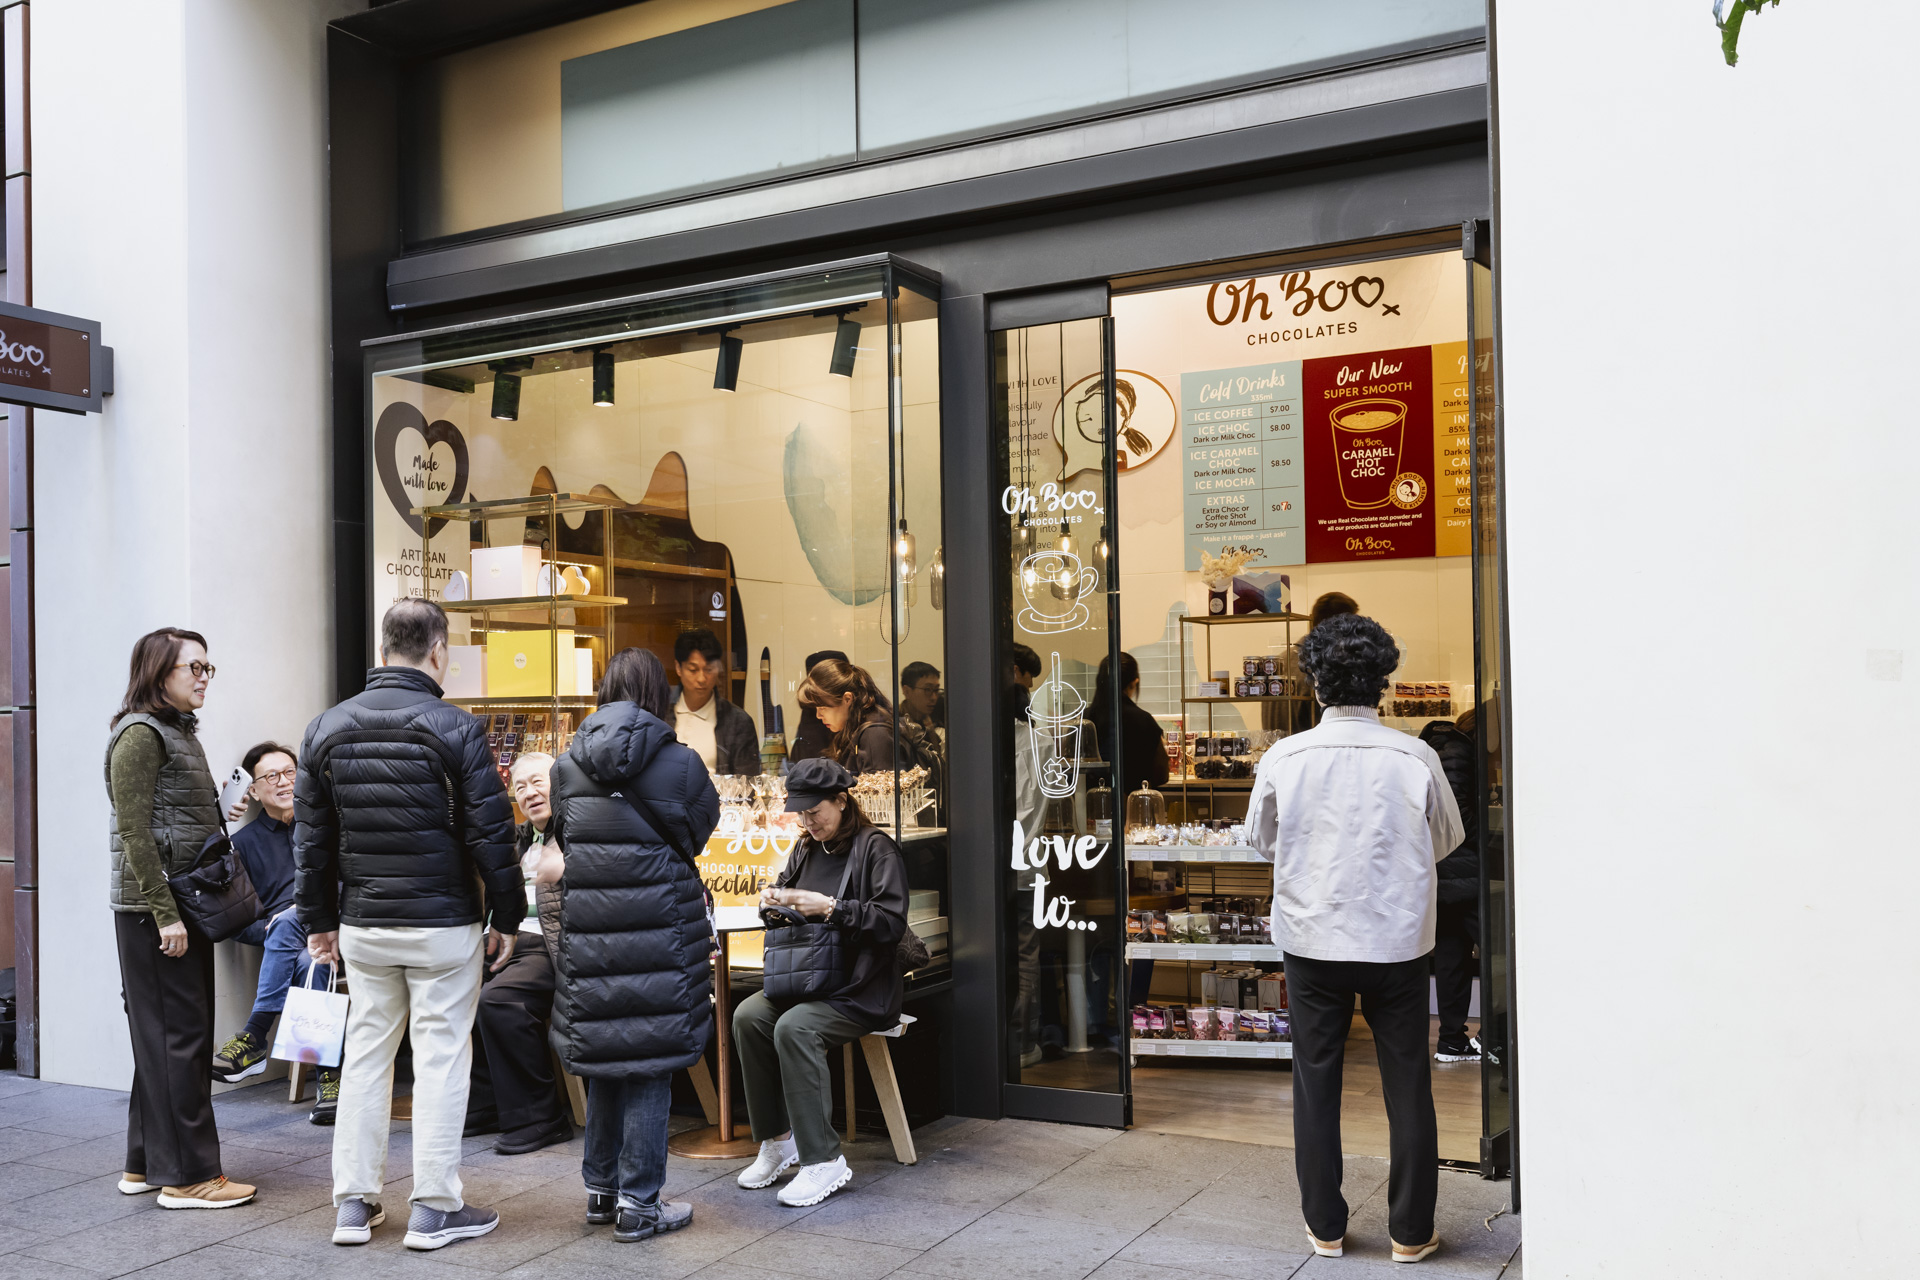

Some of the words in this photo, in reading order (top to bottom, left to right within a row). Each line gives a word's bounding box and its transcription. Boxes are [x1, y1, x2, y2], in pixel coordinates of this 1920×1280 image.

[1206, 278, 1272, 326] Oh
[1247, 322, 1358, 346] CHOCOLATES
[1336, 366, 1364, 386] Our
[1369, 358, 1402, 380] New
[1032, 376, 1057, 386] LOVE
[1200, 379, 1232, 403] Cold
[1236, 369, 1285, 395] Drinks
[1251, 393, 1272, 401] 335ml
[1324, 387, 1359, 399] SUPER
[1362, 382, 1412, 395] SMOOTH
[1194, 412, 1211, 421] ICE
[1214, 408, 1253, 419] COFFEE
[1270, 405, 1290, 413] $7.00
[1198, 426, 1215, 435] ICE
[1218, 422, 1250, 433] CHOC
[1270, 424, 1290, 432] $8.00
[1191, 451, 1207, 460] ICE
[1210, 447, 1259, 459] CARAMEL
[1342, 447, 1395, 460] CARAMEL
[413, 452, 440, 471] Made
[1209, 458, 1240, 469] CHOC
[1271, 459, 1291, 467] $8.50
[1356, 458, 1381, 468] HOT
[1351, 467, 1385, 478] CHOC
[404, 472, 425, 490] with
[427, 472, 448, 492] love
[1195, 480, 1212, 490] ICE
[1215, 477, 1255, 488] MOCHA
[1002, 485, 1038, 515] Oh
[1207, 495, 1245, 506] EXTRAS
[1024, 515, 1082, 527] CHOCOLATES
[1260, 532, 1272, 540] just
[1346, 537, 1363, 550] Oh
[401, 549, 446, 564] ARTSAN
[387, 563, 458, 580] CHOCOLATE
[1011, 820, 1110, 871] Love
[1029, 873, 1097, 931] to...
